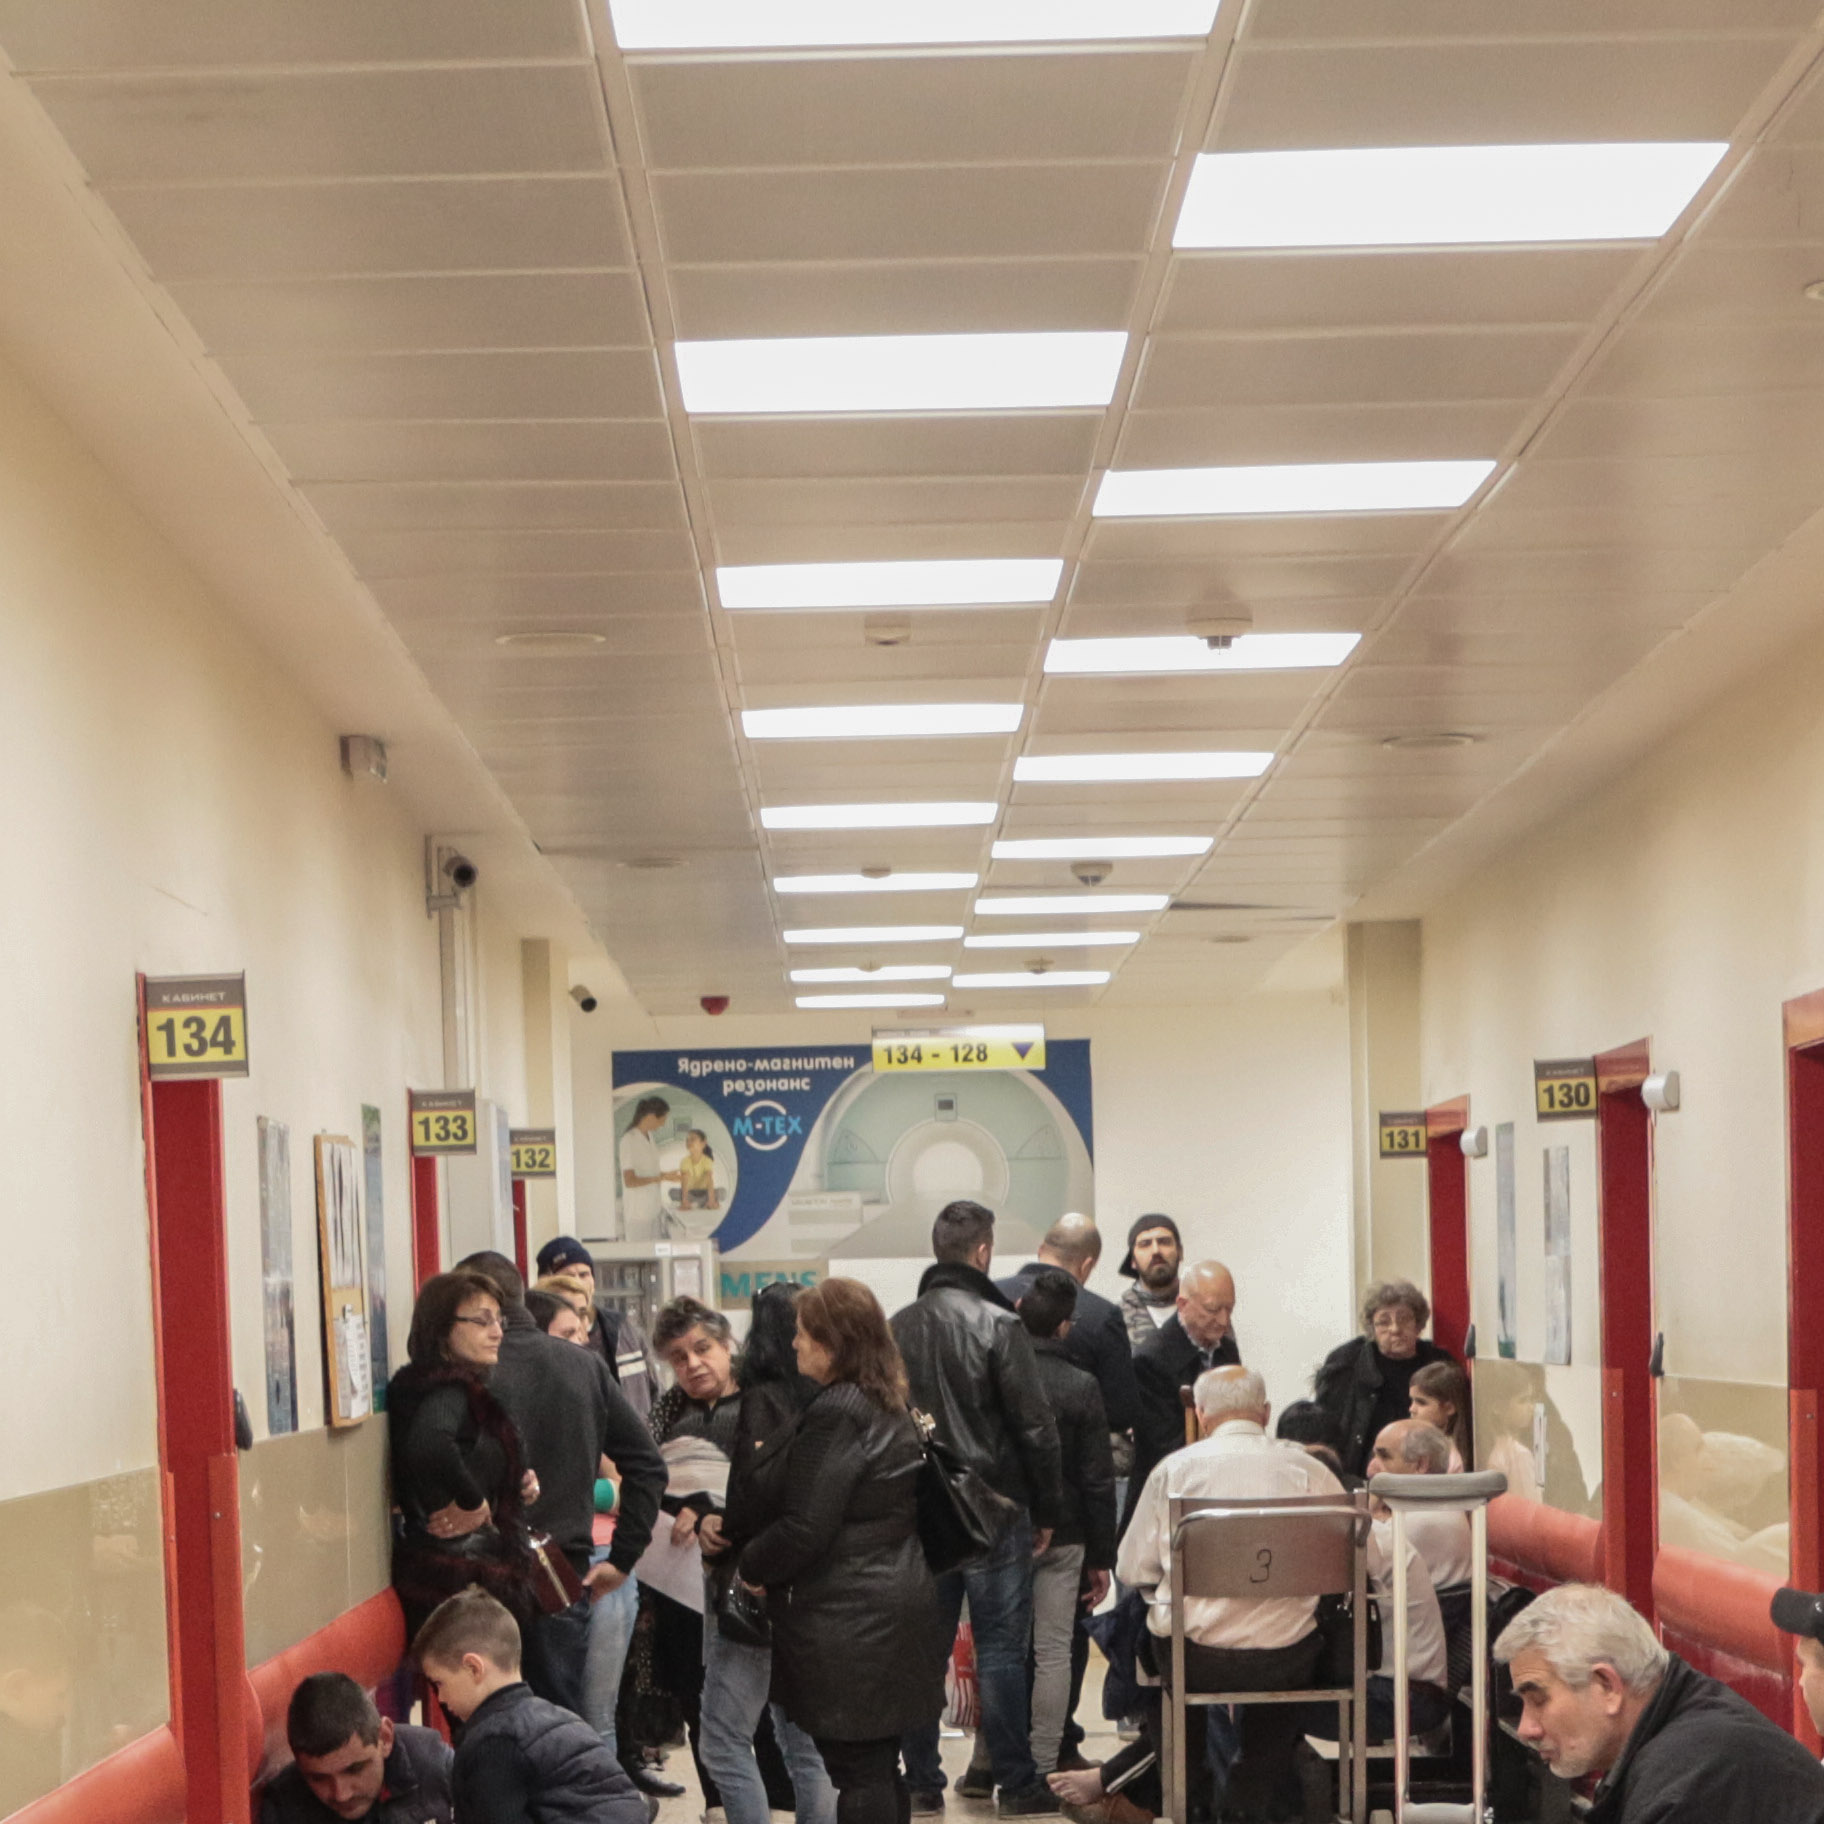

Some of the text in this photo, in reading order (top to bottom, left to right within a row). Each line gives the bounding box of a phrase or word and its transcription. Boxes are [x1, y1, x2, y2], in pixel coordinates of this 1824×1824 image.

[161, 991, 226, 1003] КАБИНЕТ
[157, 1014, 236, 1058] 134
[883, 1044, 923, 1065] 134
[950, 1042, 988, 1063] 128
[678, 1056, 855, 1078] Ядрено-магнитен
[723, 1077, 811, 1097] резонанс
[1543, 1081, 1591, 1110] 130
[418, 1114, 469, 1143] 133
[732, 1115, 803, 1136] M-TEX
[1385, 1129, 1421, 1150] 131
[512, 1147, 551, 1169] 132
[1249, 1548, 1272, 1584] 3
